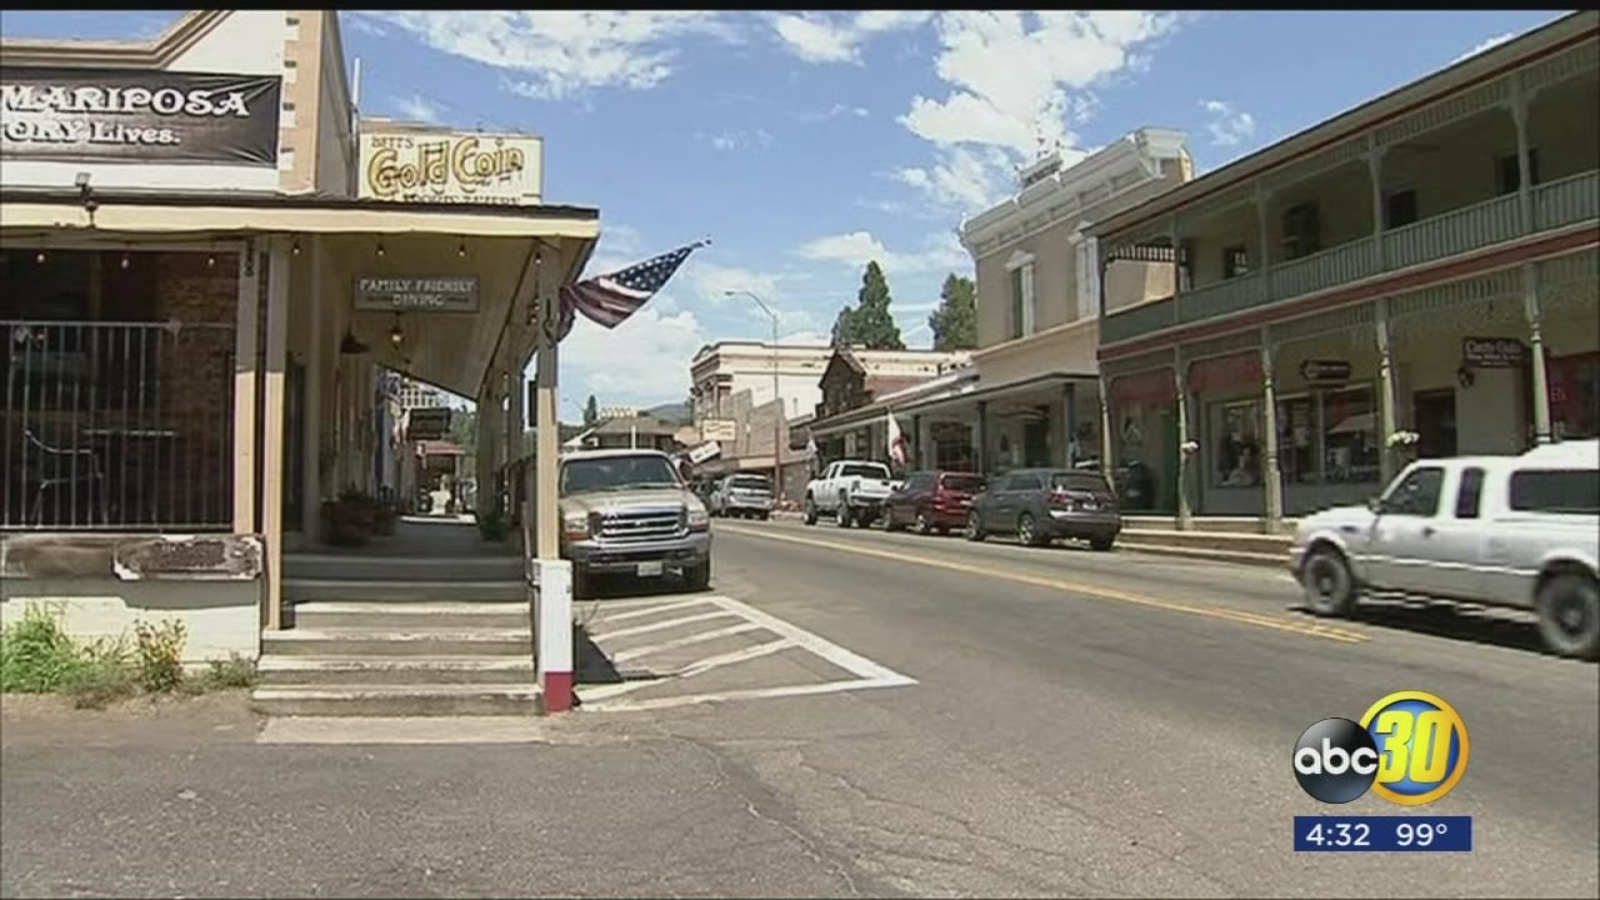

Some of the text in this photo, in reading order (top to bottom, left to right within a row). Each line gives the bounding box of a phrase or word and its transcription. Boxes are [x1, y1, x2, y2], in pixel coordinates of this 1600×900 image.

[0, 85, 250, 116] MARIPOSA
[0, 118, 181, 145] ORY Lives.
[368, 136, 525, 196] Gold Coin
[360, 279, 411, 291] FAMILY
